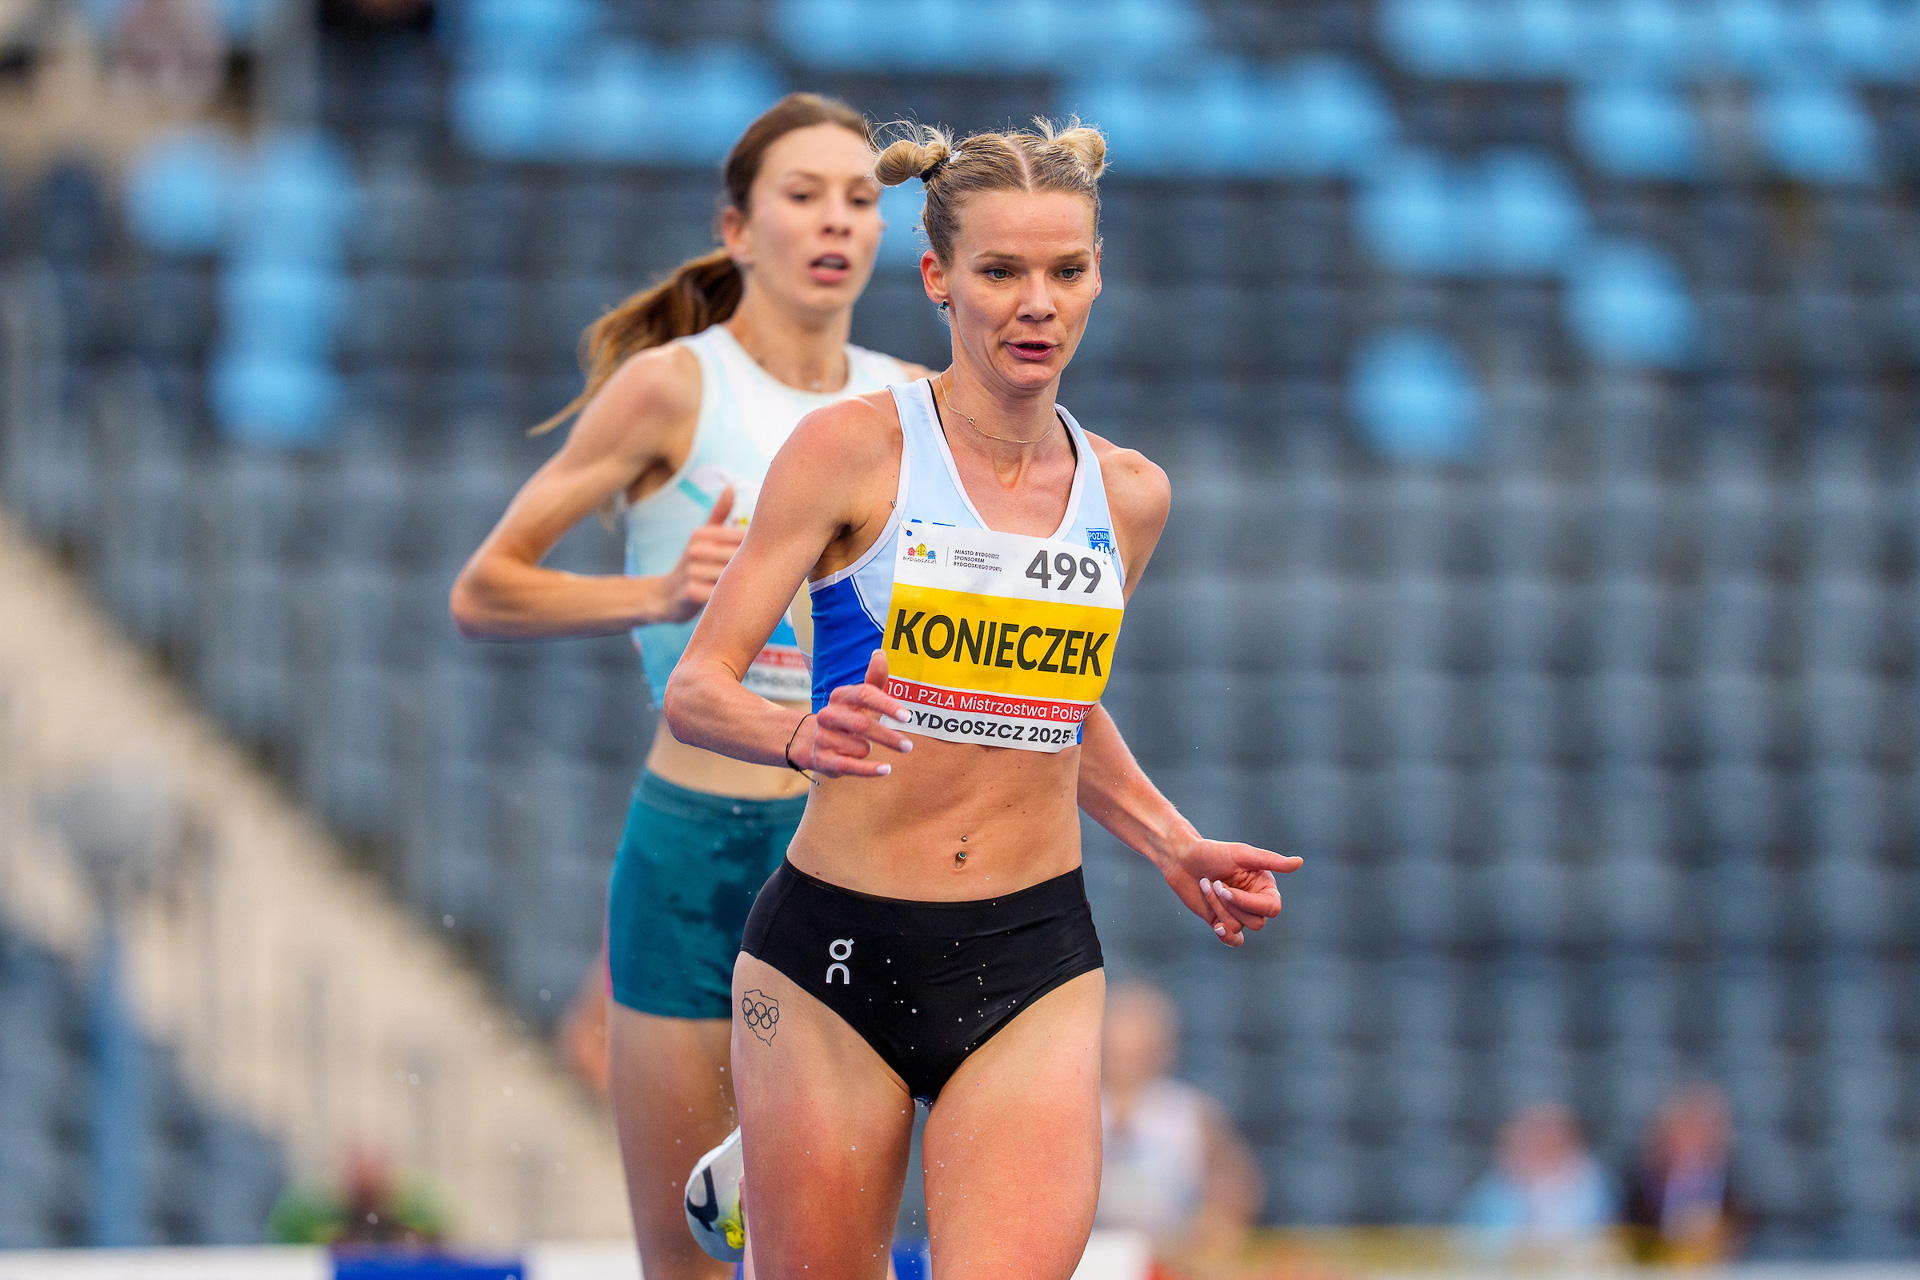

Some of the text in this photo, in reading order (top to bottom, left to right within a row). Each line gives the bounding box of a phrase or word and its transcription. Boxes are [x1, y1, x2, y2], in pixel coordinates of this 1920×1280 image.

[954, 555, 985, 563] SPONSOREM
[1025, 550, 1102, 594] 499
[891, 608, 1110, 677] KONIECZEK
[887, 681, 1090, 721] 101. PZLA Mistrzostwa Polski
[1027, 726, 1072, 744] 2025
